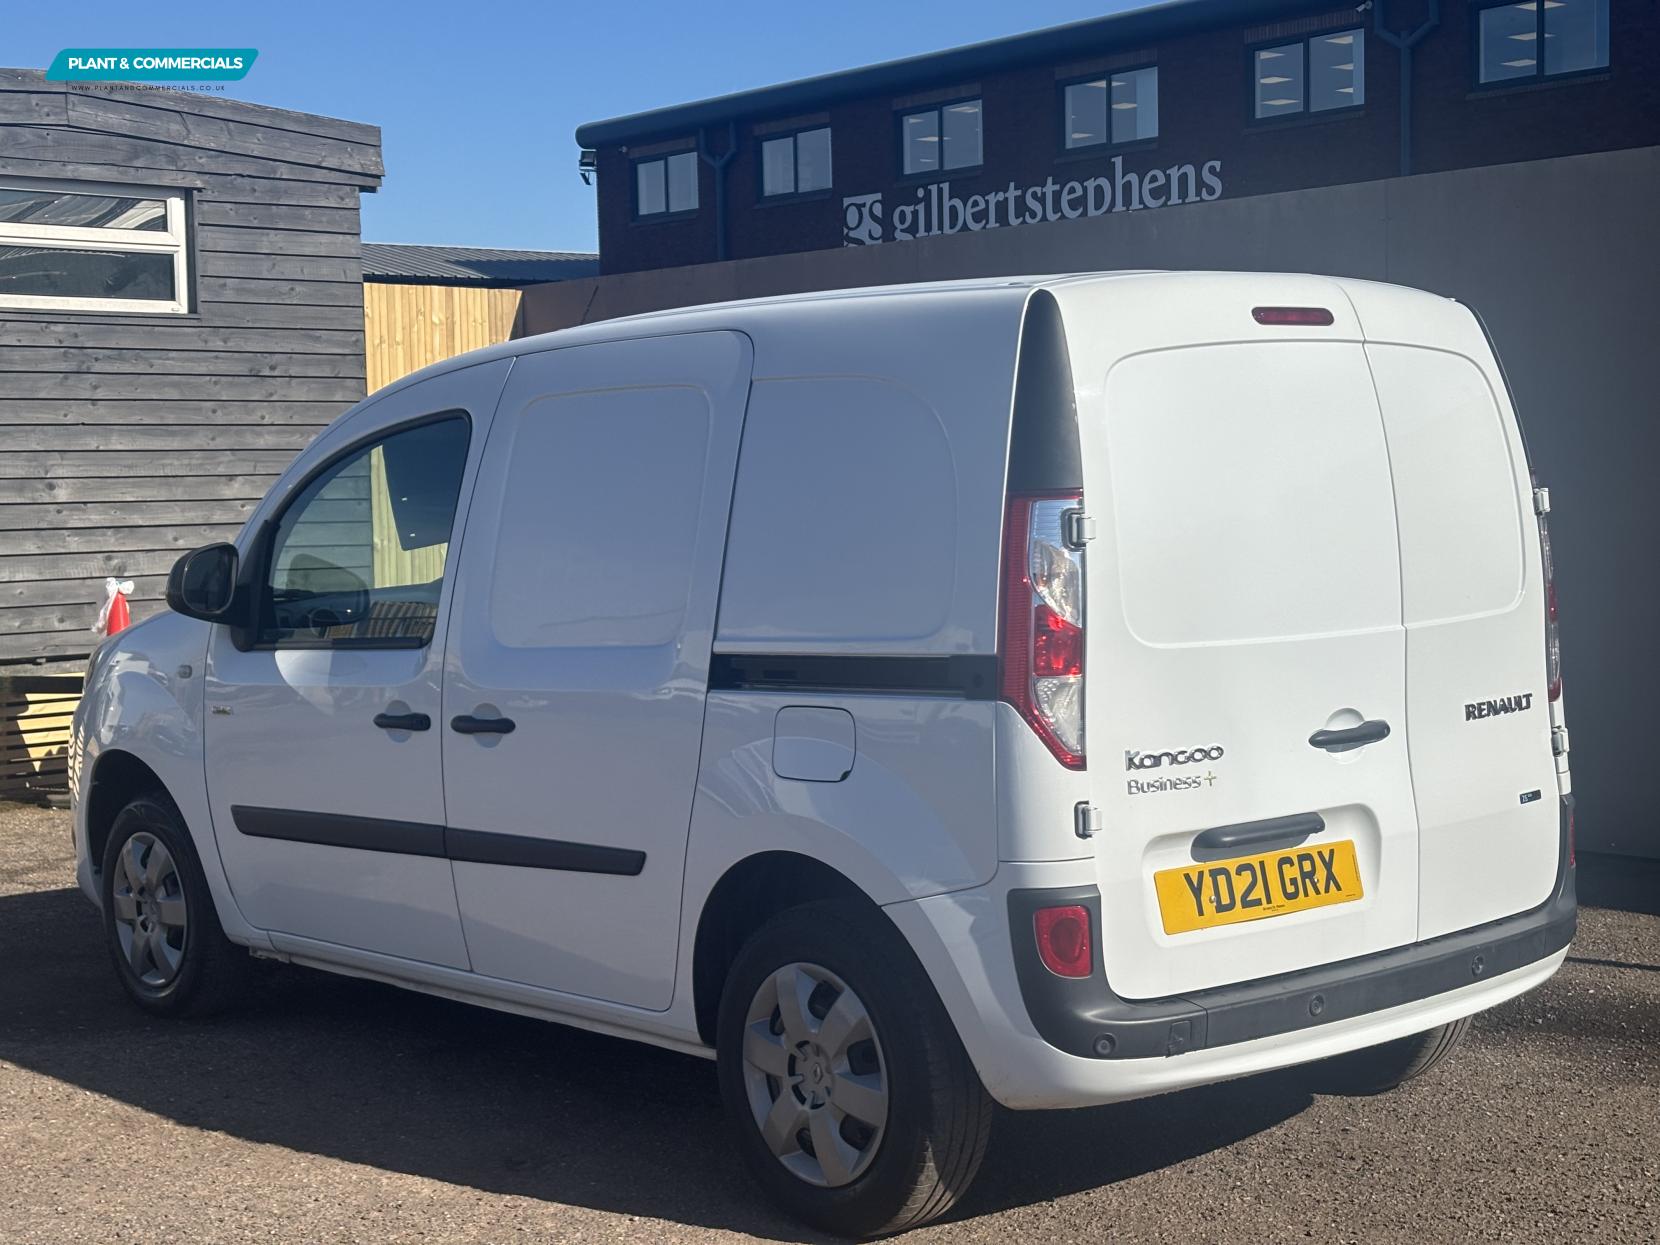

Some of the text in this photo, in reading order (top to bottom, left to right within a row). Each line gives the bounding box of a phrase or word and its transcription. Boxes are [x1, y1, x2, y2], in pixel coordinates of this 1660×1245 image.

[892, 155, 1223, 242] gilbertstephens
[1464, 693, 1533, 721] RENAULT
[1183, 860, 1273, 917] YD21
[1277, 848, 1343, 901] GRX
